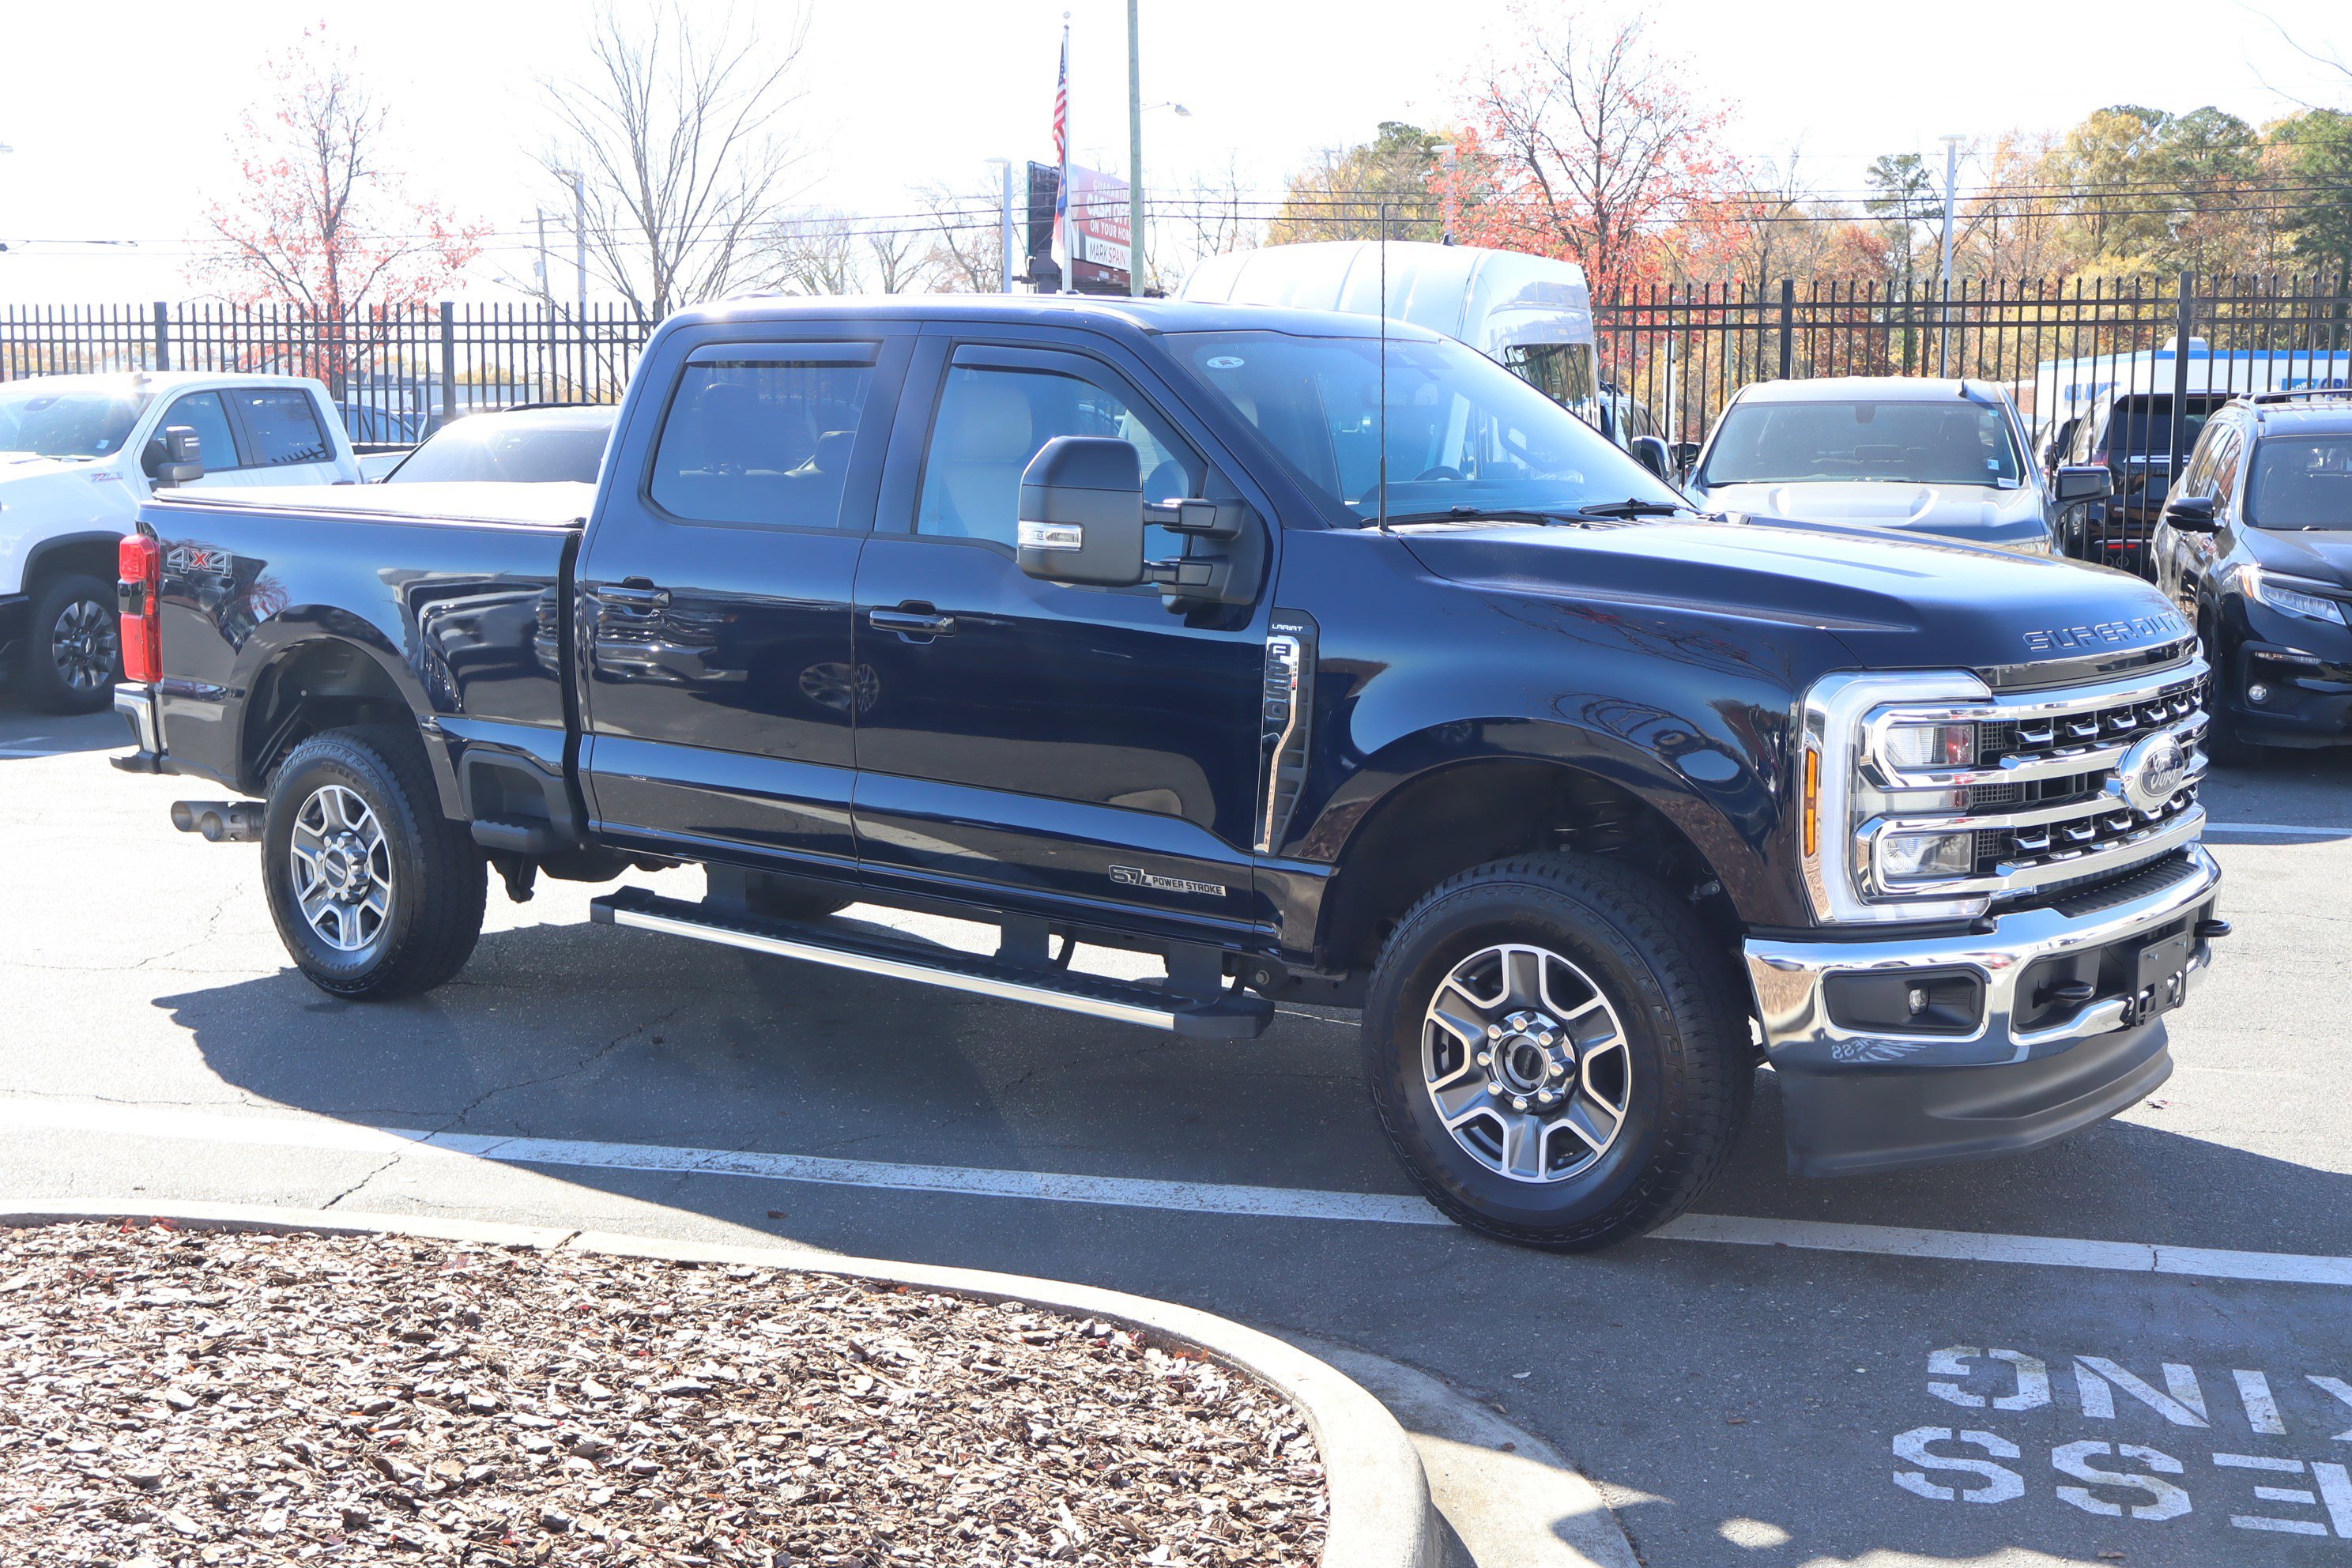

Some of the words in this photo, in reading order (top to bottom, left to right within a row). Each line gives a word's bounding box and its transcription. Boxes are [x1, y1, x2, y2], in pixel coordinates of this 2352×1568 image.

[1087, 194, 1111, 221] CASH
[1113, 202, 1130, 226] OFF
[1091, 220, 1099, 234] ON
[1101, 222, 1117, 239] YOUR
[1118, 227, 1130, 242] HOM
[1090, 241, 1108, 264] MARK
[1108, 247, 1126, 266] SPAIN
[1272, 624, 1303, 632] LARIAT
[1152, 876, 1184, 888] POWER
[1185, 881, 1222, 895] STROKE
